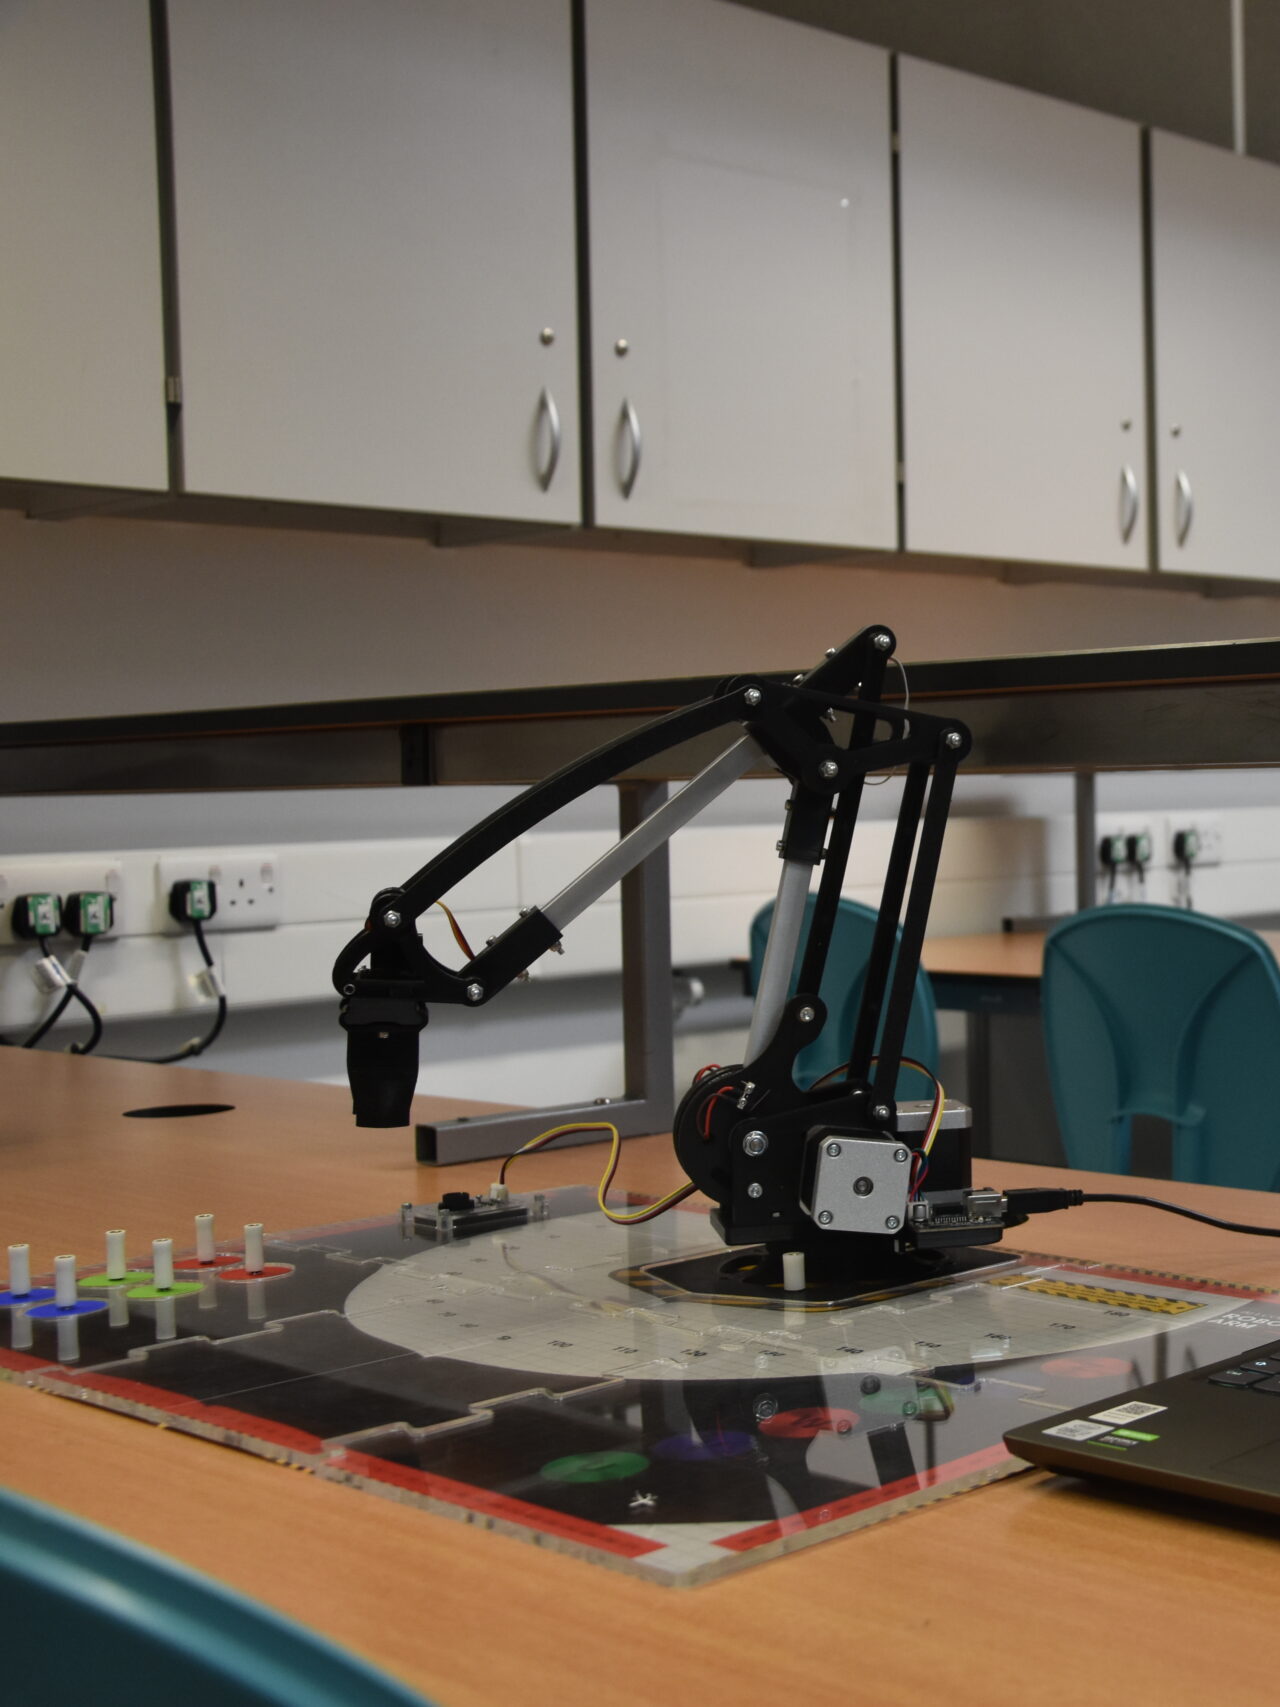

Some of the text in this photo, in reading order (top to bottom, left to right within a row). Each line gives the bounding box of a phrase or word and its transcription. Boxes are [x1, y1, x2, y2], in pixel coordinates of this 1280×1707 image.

[1049, 1322, 1076, 1330] 170
[1207, 1318, 1259, 1329] ARM
[547, 1340, 574, 1348] 100
[913, 1340, 942, 1349] 150
[612, 1346, 639, 1355] 110
[835, 1346, 865, 1355] 140
